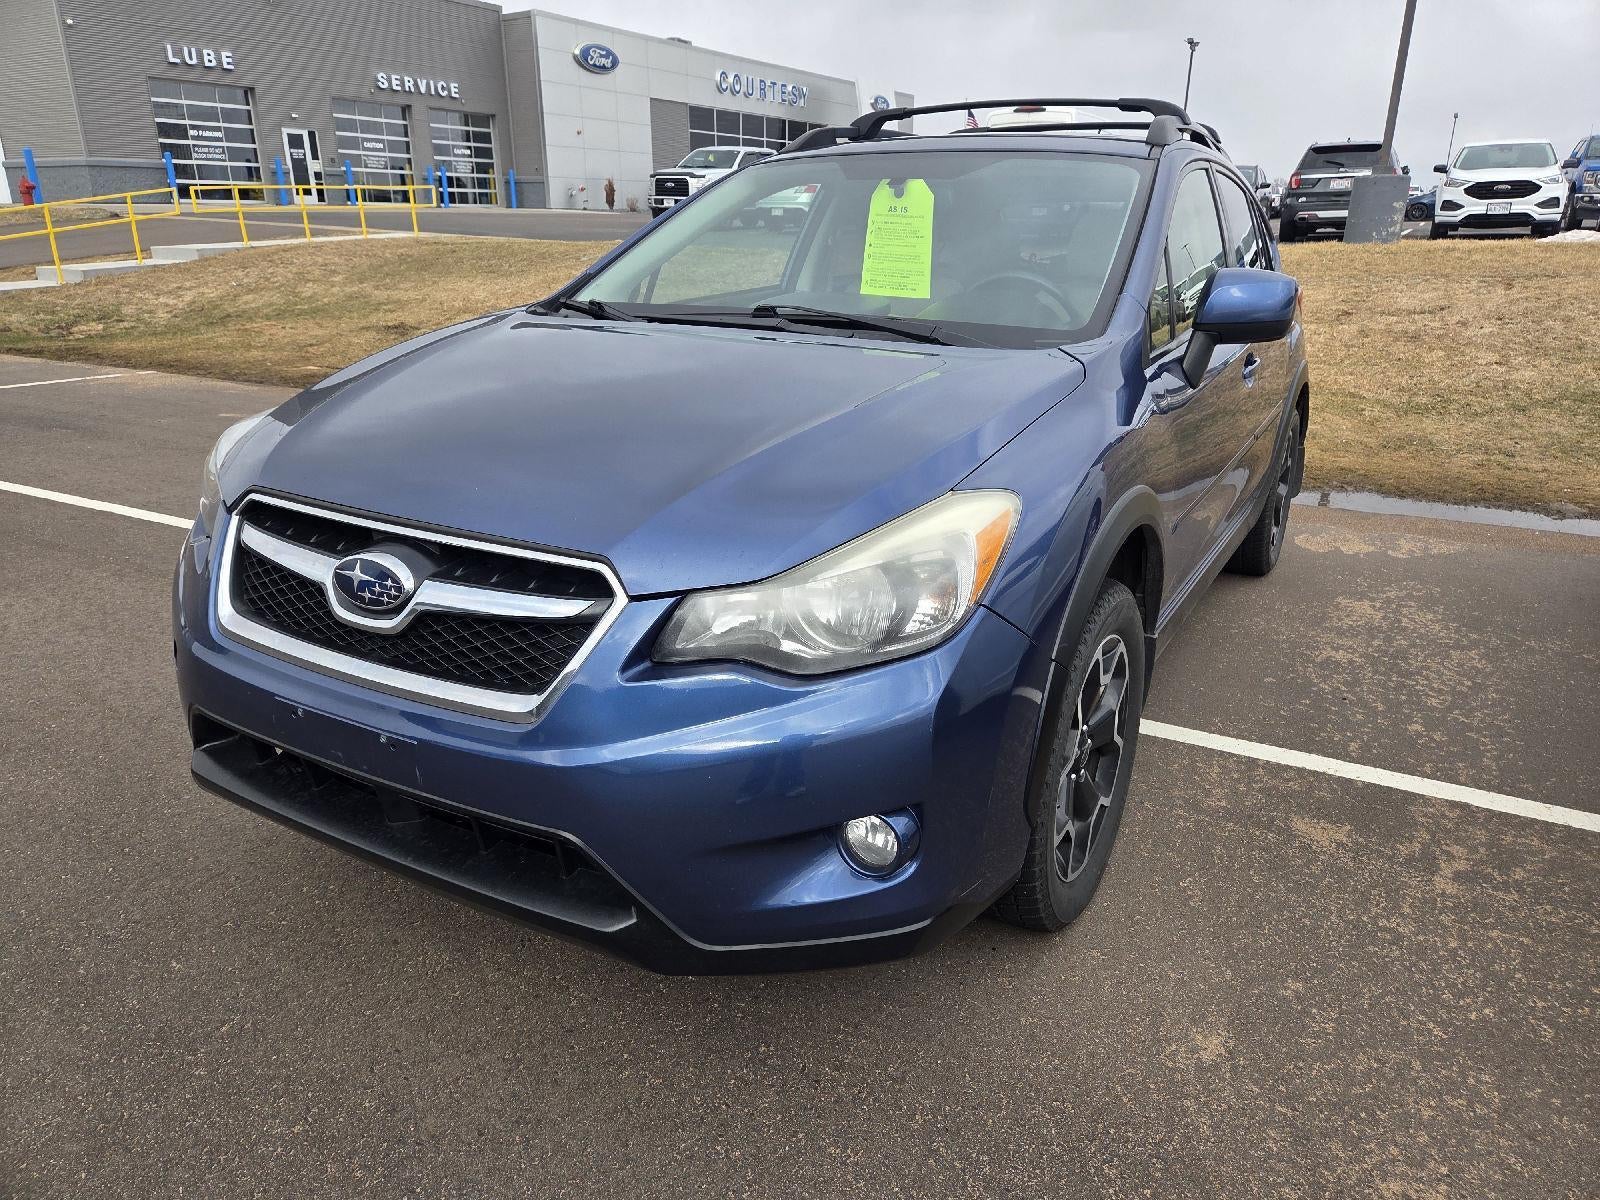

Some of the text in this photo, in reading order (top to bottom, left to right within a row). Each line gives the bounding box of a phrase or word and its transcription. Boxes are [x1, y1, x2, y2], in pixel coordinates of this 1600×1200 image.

[165, 43, 235, 70] LUBE
[587, 47, 613, 68] Ford
[375, 72, 460, 98] SERVICE
[716, 70, 809, 107] COURTESY
[199, 130, 223, 138] PARKING
[363, 141, 384, 149] CAUTION
[888, 205, 909, 214] AS IS
